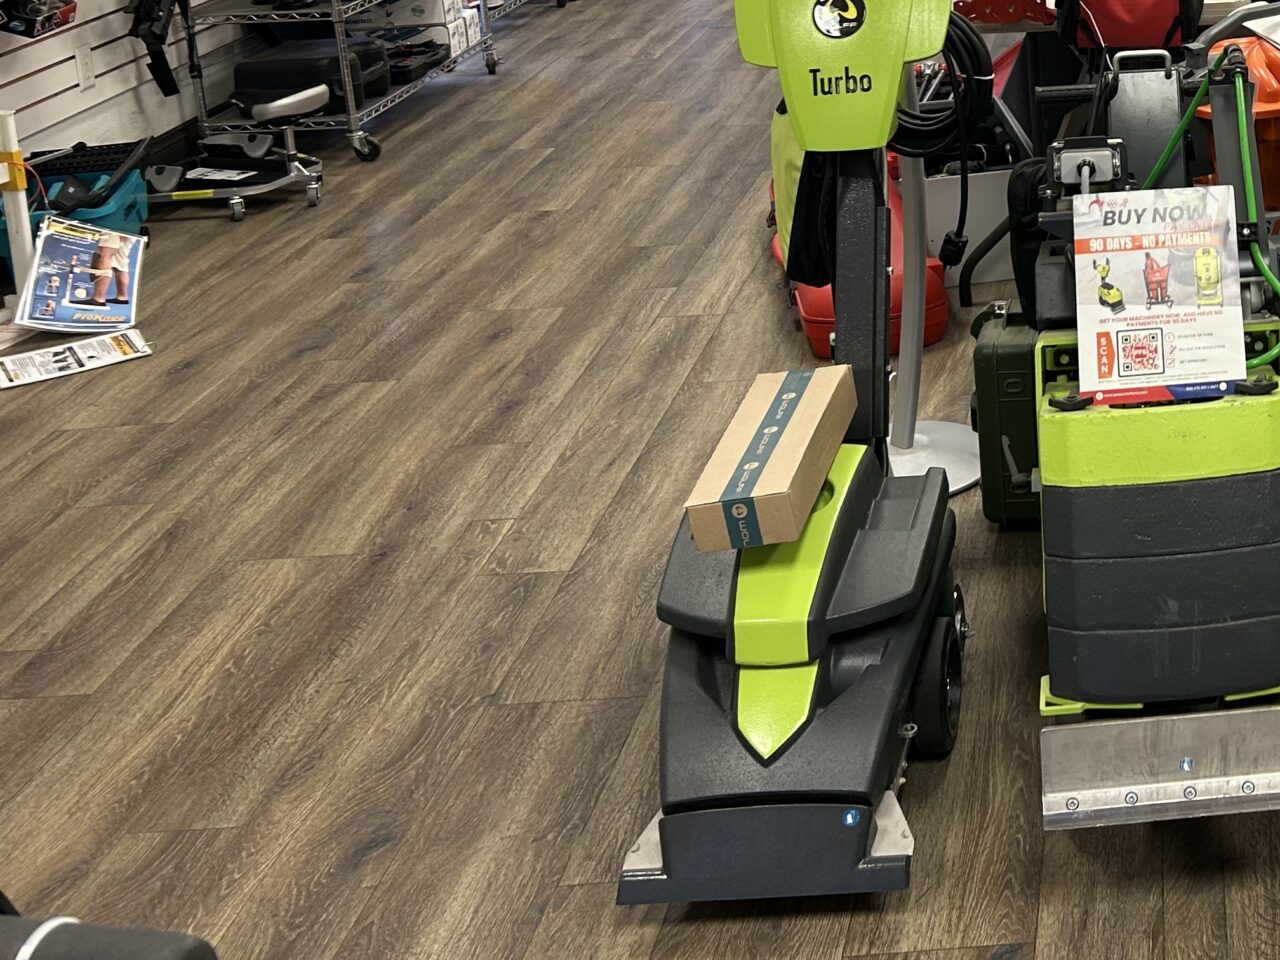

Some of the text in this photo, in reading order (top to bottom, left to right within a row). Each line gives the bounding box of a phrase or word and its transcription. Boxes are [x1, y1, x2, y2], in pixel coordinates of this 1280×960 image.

[808, 66, 872, 96] Turbo
[1103, 203, 1206, 227] BUY NOW
[1089, 239, 1103, 252] 90
[1106, 236, 1133, 250] DAYS
[1142, 235, 1156, 248] NO
[1158, 231, 1211, 247] PAYMENTS
[72, 312, 127, 323] ProKnee
[1129, 314, 1164, 322] MACHINERY
[1100, 337, 1108, 374] SCAN
